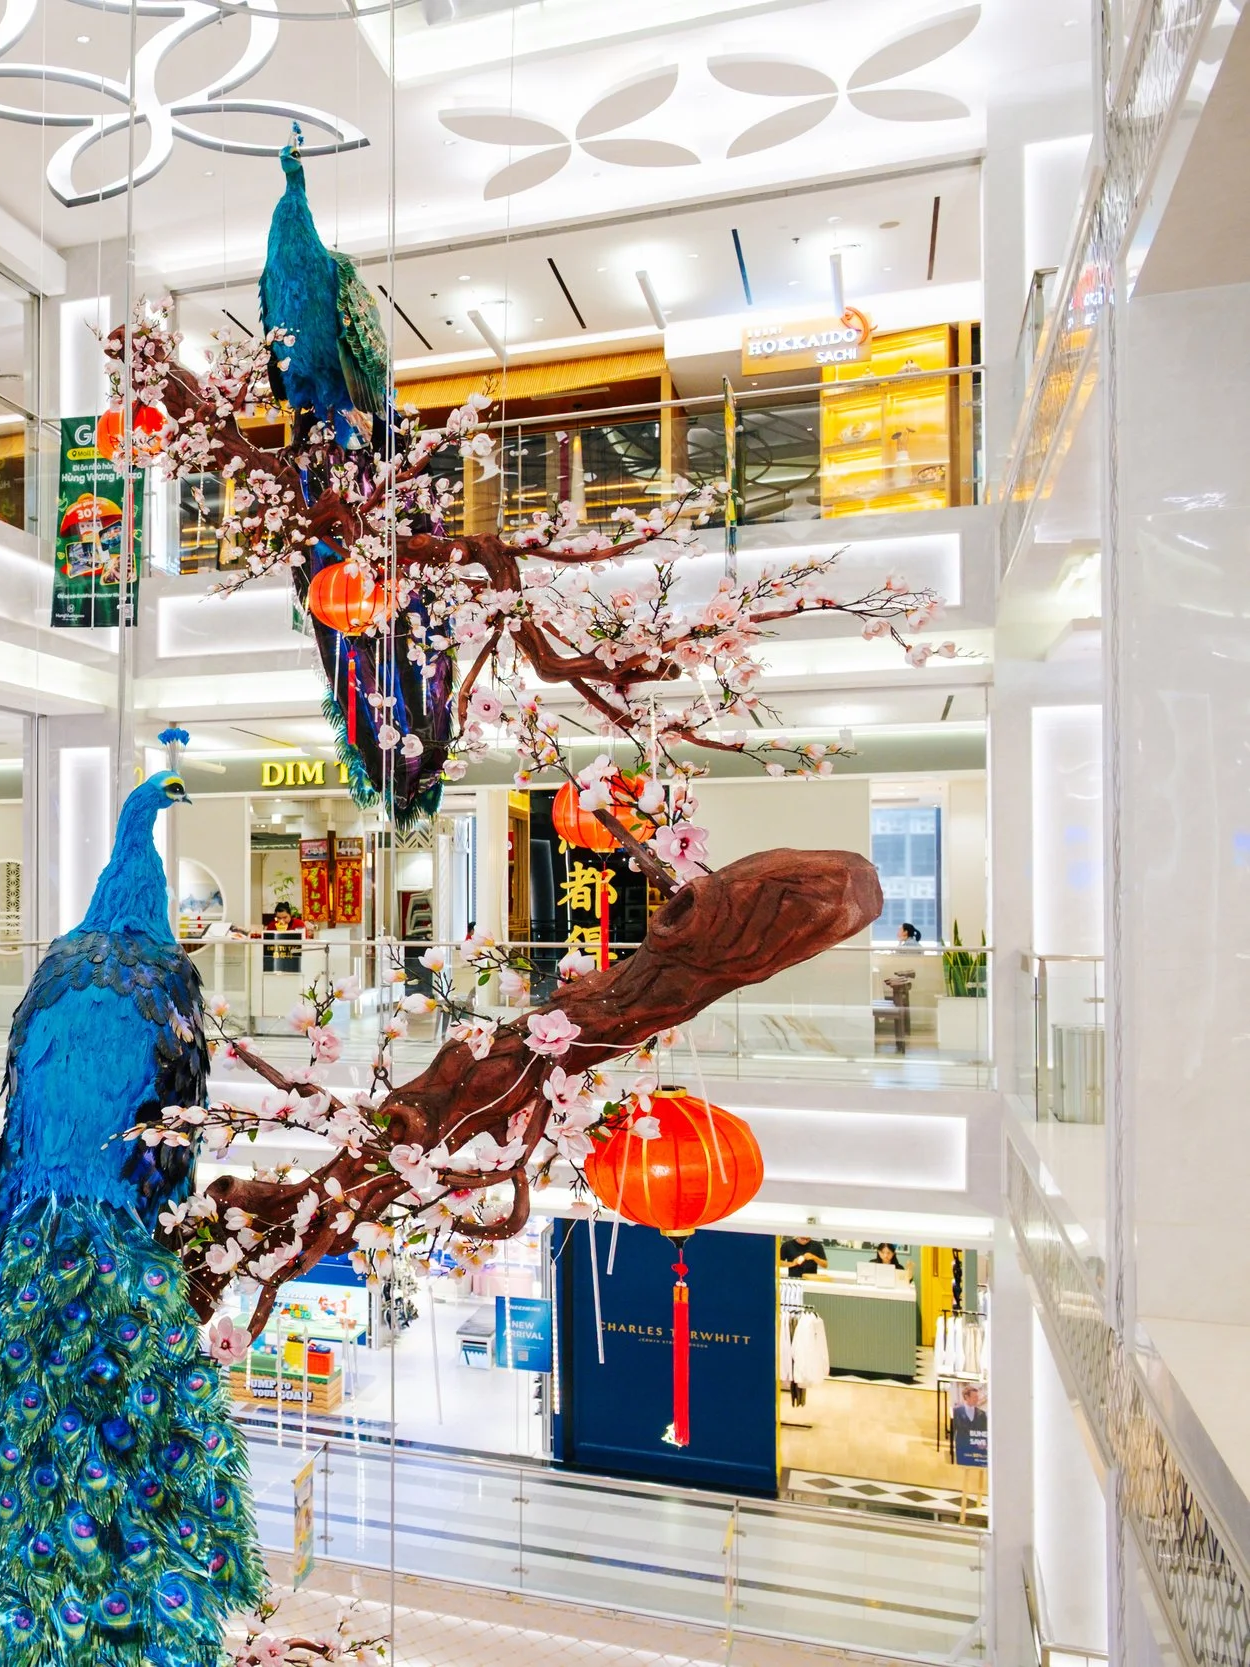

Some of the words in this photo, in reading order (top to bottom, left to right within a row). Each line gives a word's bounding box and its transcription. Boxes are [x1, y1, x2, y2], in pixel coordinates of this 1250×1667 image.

[747, 328, 858, 356] HOKKAIDO
[816, 347, 857, 364] SACHI
[61, 472, 85, 484] Hùng
[261, 760, 325, 787] DIM
[511, 1320, 535, 1330] NEW
[600, 1321, 663, 1336] CHARLES
[669, 1328, 751, 1345] TRWHITT
[252, 1389, 277, 1398] YOUR
